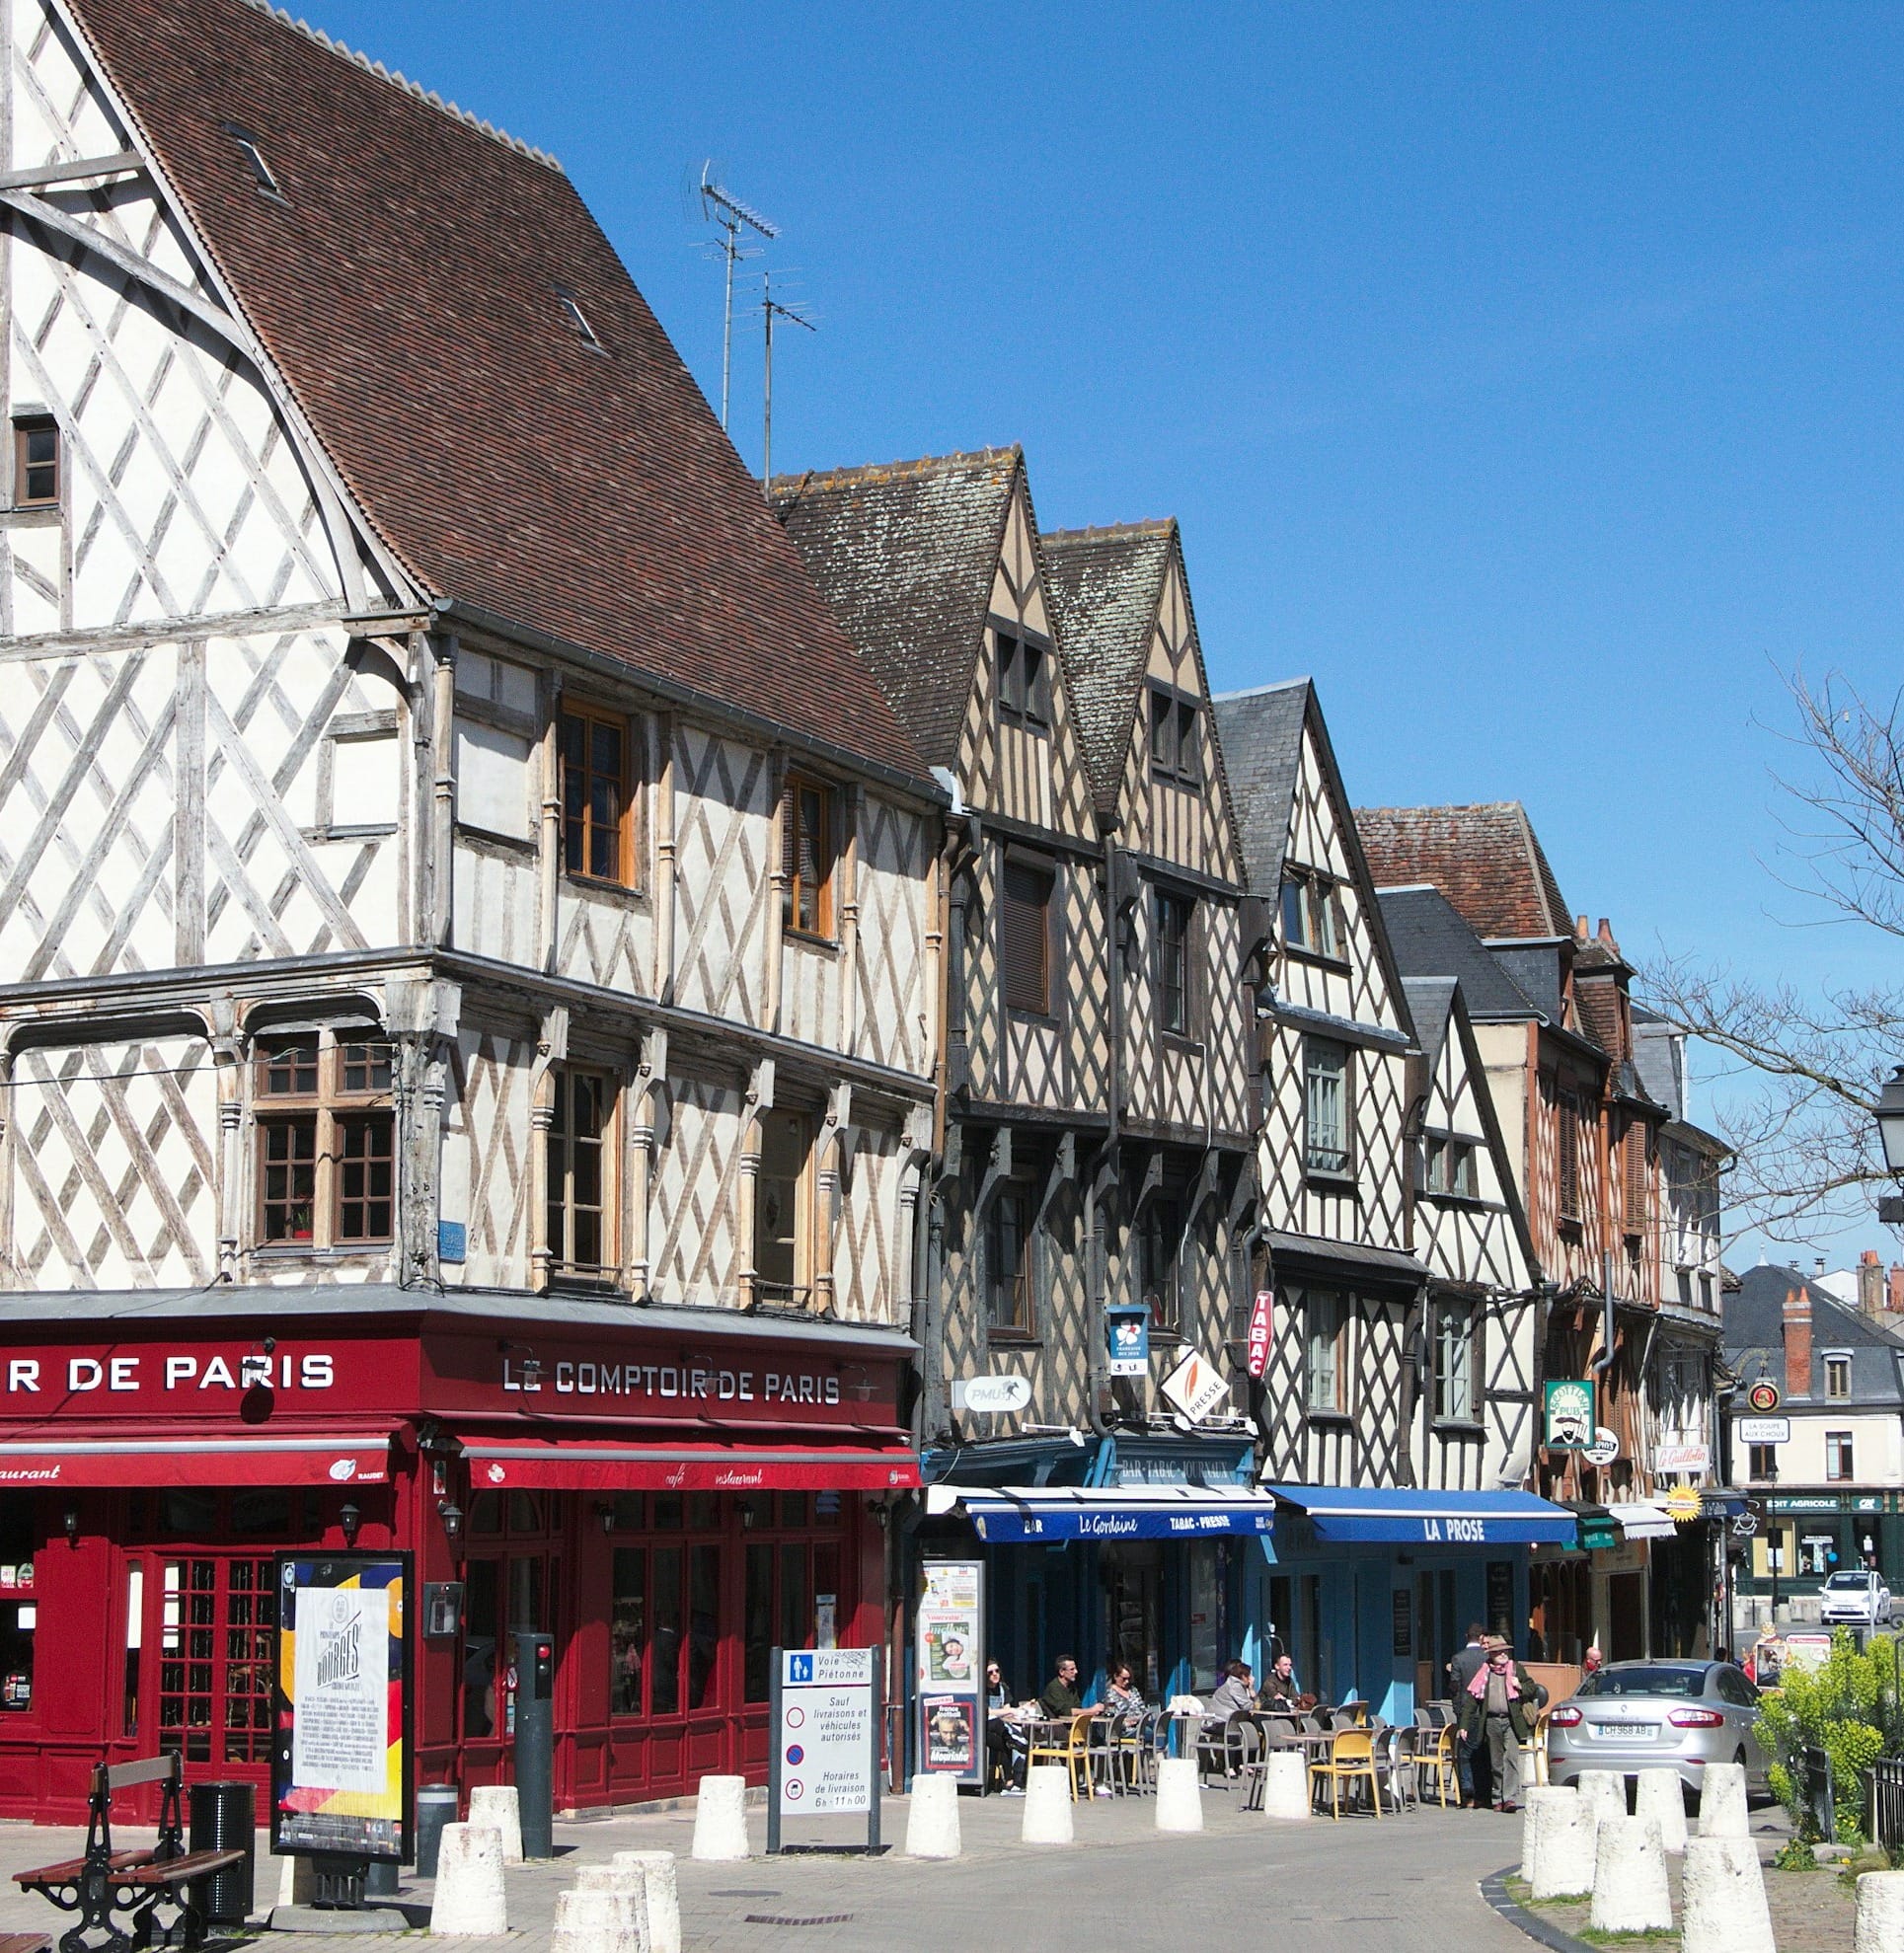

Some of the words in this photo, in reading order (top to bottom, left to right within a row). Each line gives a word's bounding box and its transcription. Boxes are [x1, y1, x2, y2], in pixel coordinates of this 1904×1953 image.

[1250, 1295, 1268, 1375] TABAC
[68, 1357, 140, 1392] DE
[166, 1354, 335, 1391] PARIS
[503, 1358, 542, 1391] LE
[556, 1361, 708, 1399] COMPTOIR
[718, 1371, 755, 1401] DE
[765, 1373, 840, 1404] PARIS
[971, 1389, 1001, 1400] PMU
[1189, 1381, 1222, 1415] PRESSE
[1551, 1386, 1588, 1410] SCOTTISH
[1560, 1406, 1580, 1415] PUB
[1122, 1460, 1142, 1477] BAR
[1146, 1460, 1177, 1478] TABAC
[1182, 1461, 1228, 1478] JOURNAUX
[665, 1463, 686, 1488] café
[716, 1468, 763, 1485] restaurant
[1790, 1499, 1837, 1508] AGRICOLE
[1024, 1519, 1043, 1535] BAR
[1079, 1514, 1092, 1535] Le
[1093, 1515, 1138, 1536] Gordaine
[1170, 1517, 1195, 1531] TABAC
[1199, 1515, 1231, 1529] PRESSE
[1423, 1518, 1441, 1540] LA
[1445, 1518, 1485, 1541] PROSE
[818, 1656, 840, 1666] Voie
[818, 1669, 864, 1679] Piétonne
[829, 1696, 850, 1706] Sauf
[814, 1708, 855, 1718] livraisons
[820, 1720, 861, 1730] véhicules
[820, 1732, 861, 1742] autorisés
[822, 1770, 860, 1781] Horaires
[815, 1784, 825, 1793] de
[828, 1784, 865, 1793] livraison
